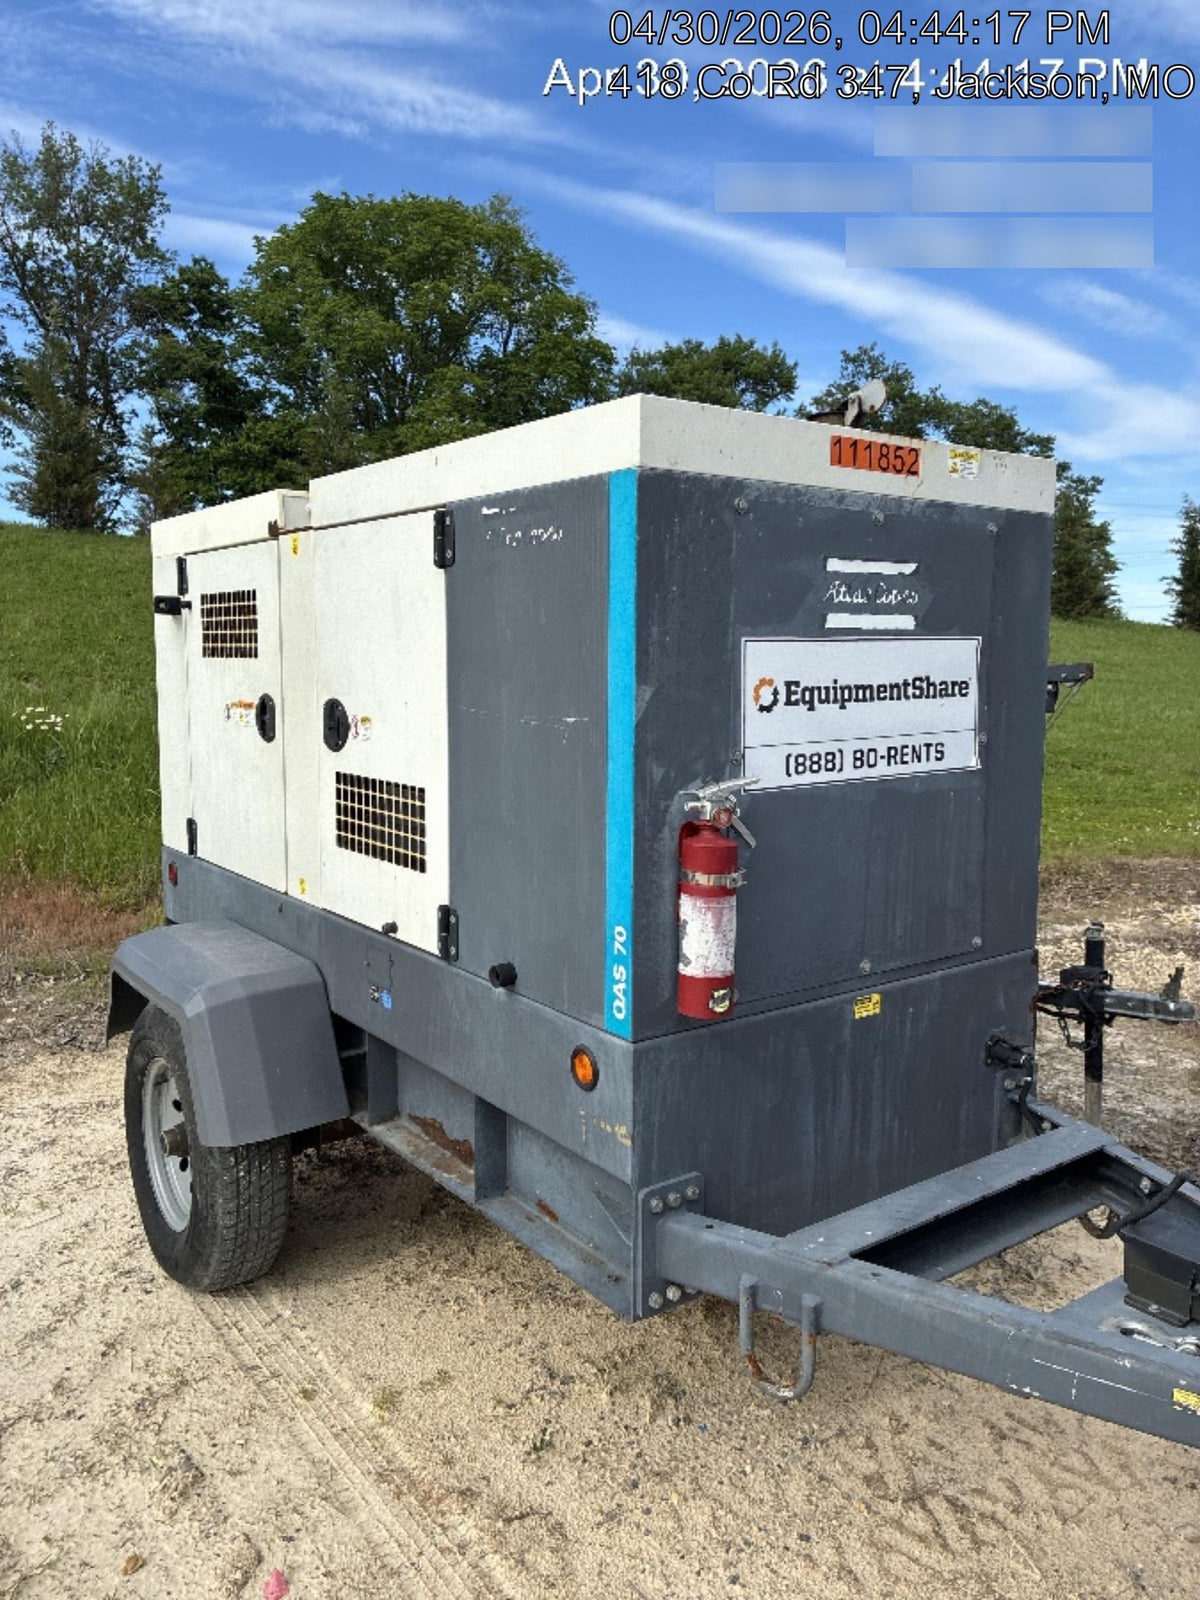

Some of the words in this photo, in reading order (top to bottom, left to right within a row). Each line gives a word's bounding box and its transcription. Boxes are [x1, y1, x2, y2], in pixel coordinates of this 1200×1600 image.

[832, 435, 920, 476] 111852
[784, 675, 970, 711] EquipmentShare
[785, 748, 844, 777] (888)
[613, 925, 627, 956] 70
